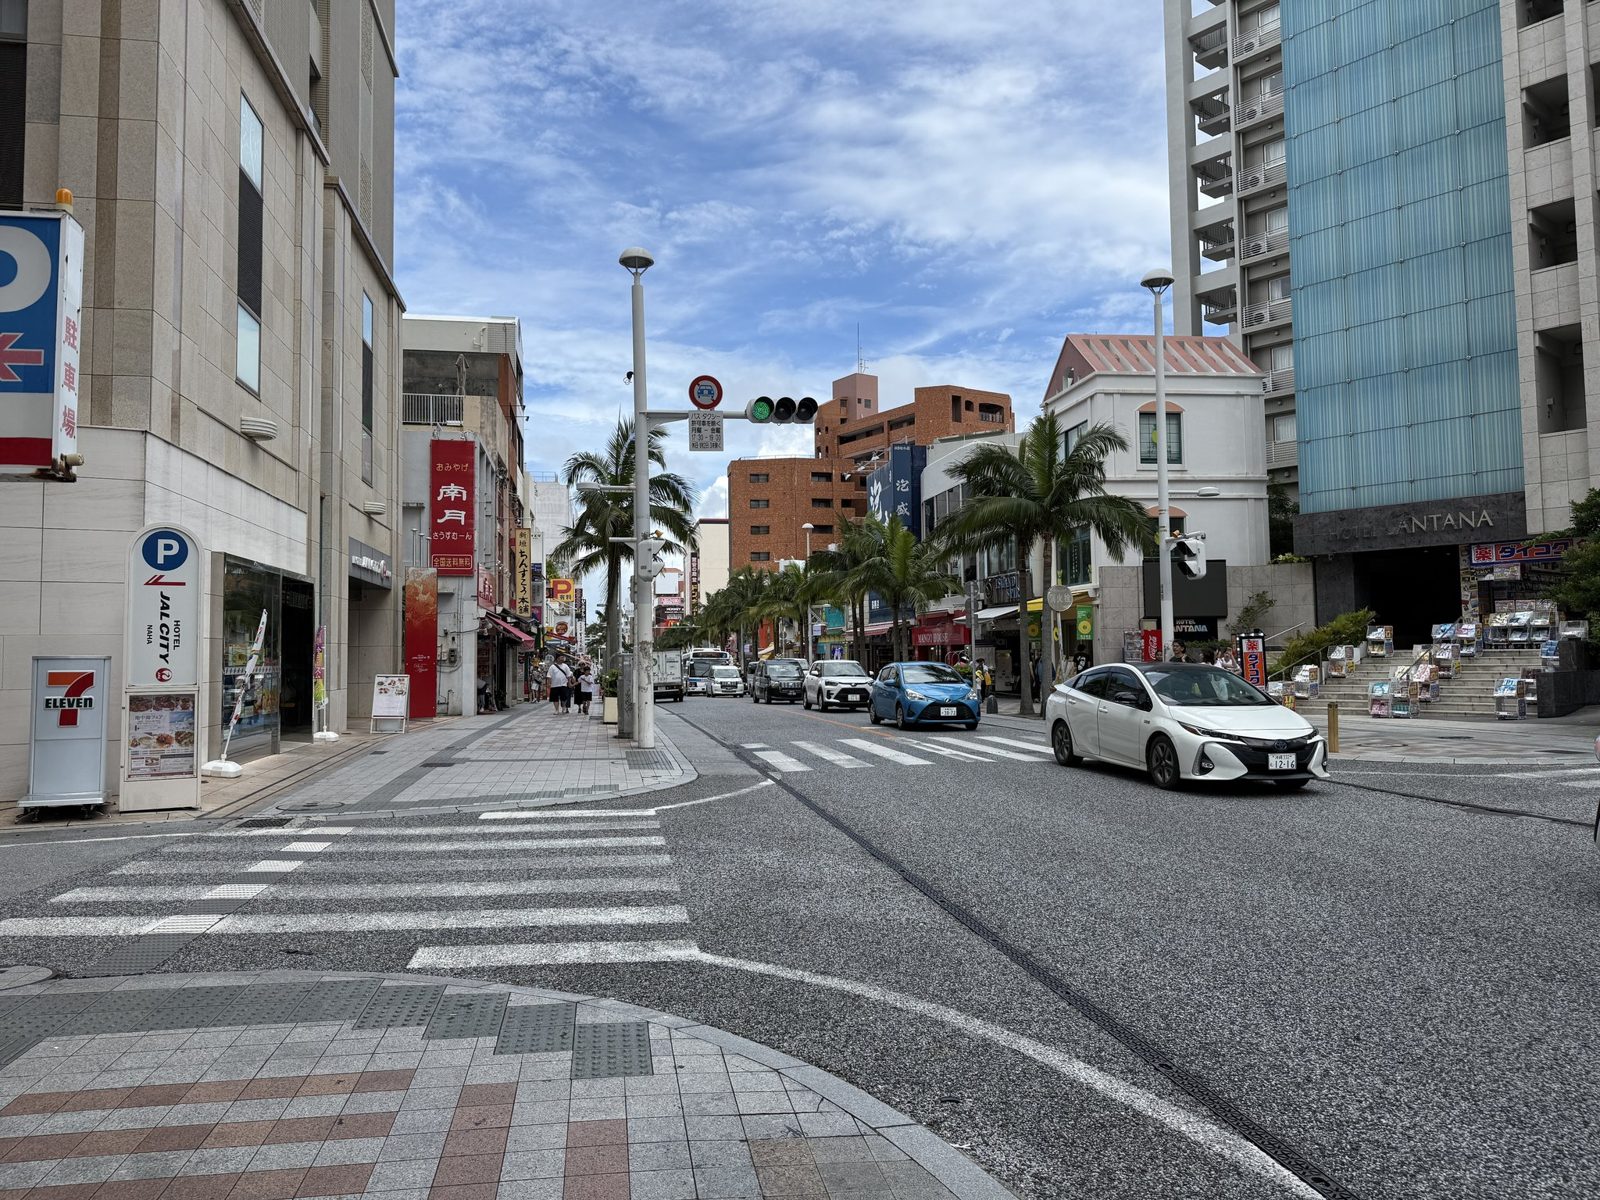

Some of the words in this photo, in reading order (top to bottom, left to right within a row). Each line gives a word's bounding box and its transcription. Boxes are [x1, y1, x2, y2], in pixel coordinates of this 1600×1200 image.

[62, 316, 78, 439] 駐車場
[436, 463, 469, 472] おみやげ
[437, 483, 467, 526] 南月
[896, 479, 910, 530] 泡盛
[157, 539, 180, 565] P
[1474, 545, 1493, 561] 薬
[553, 580, 572, 600] P
